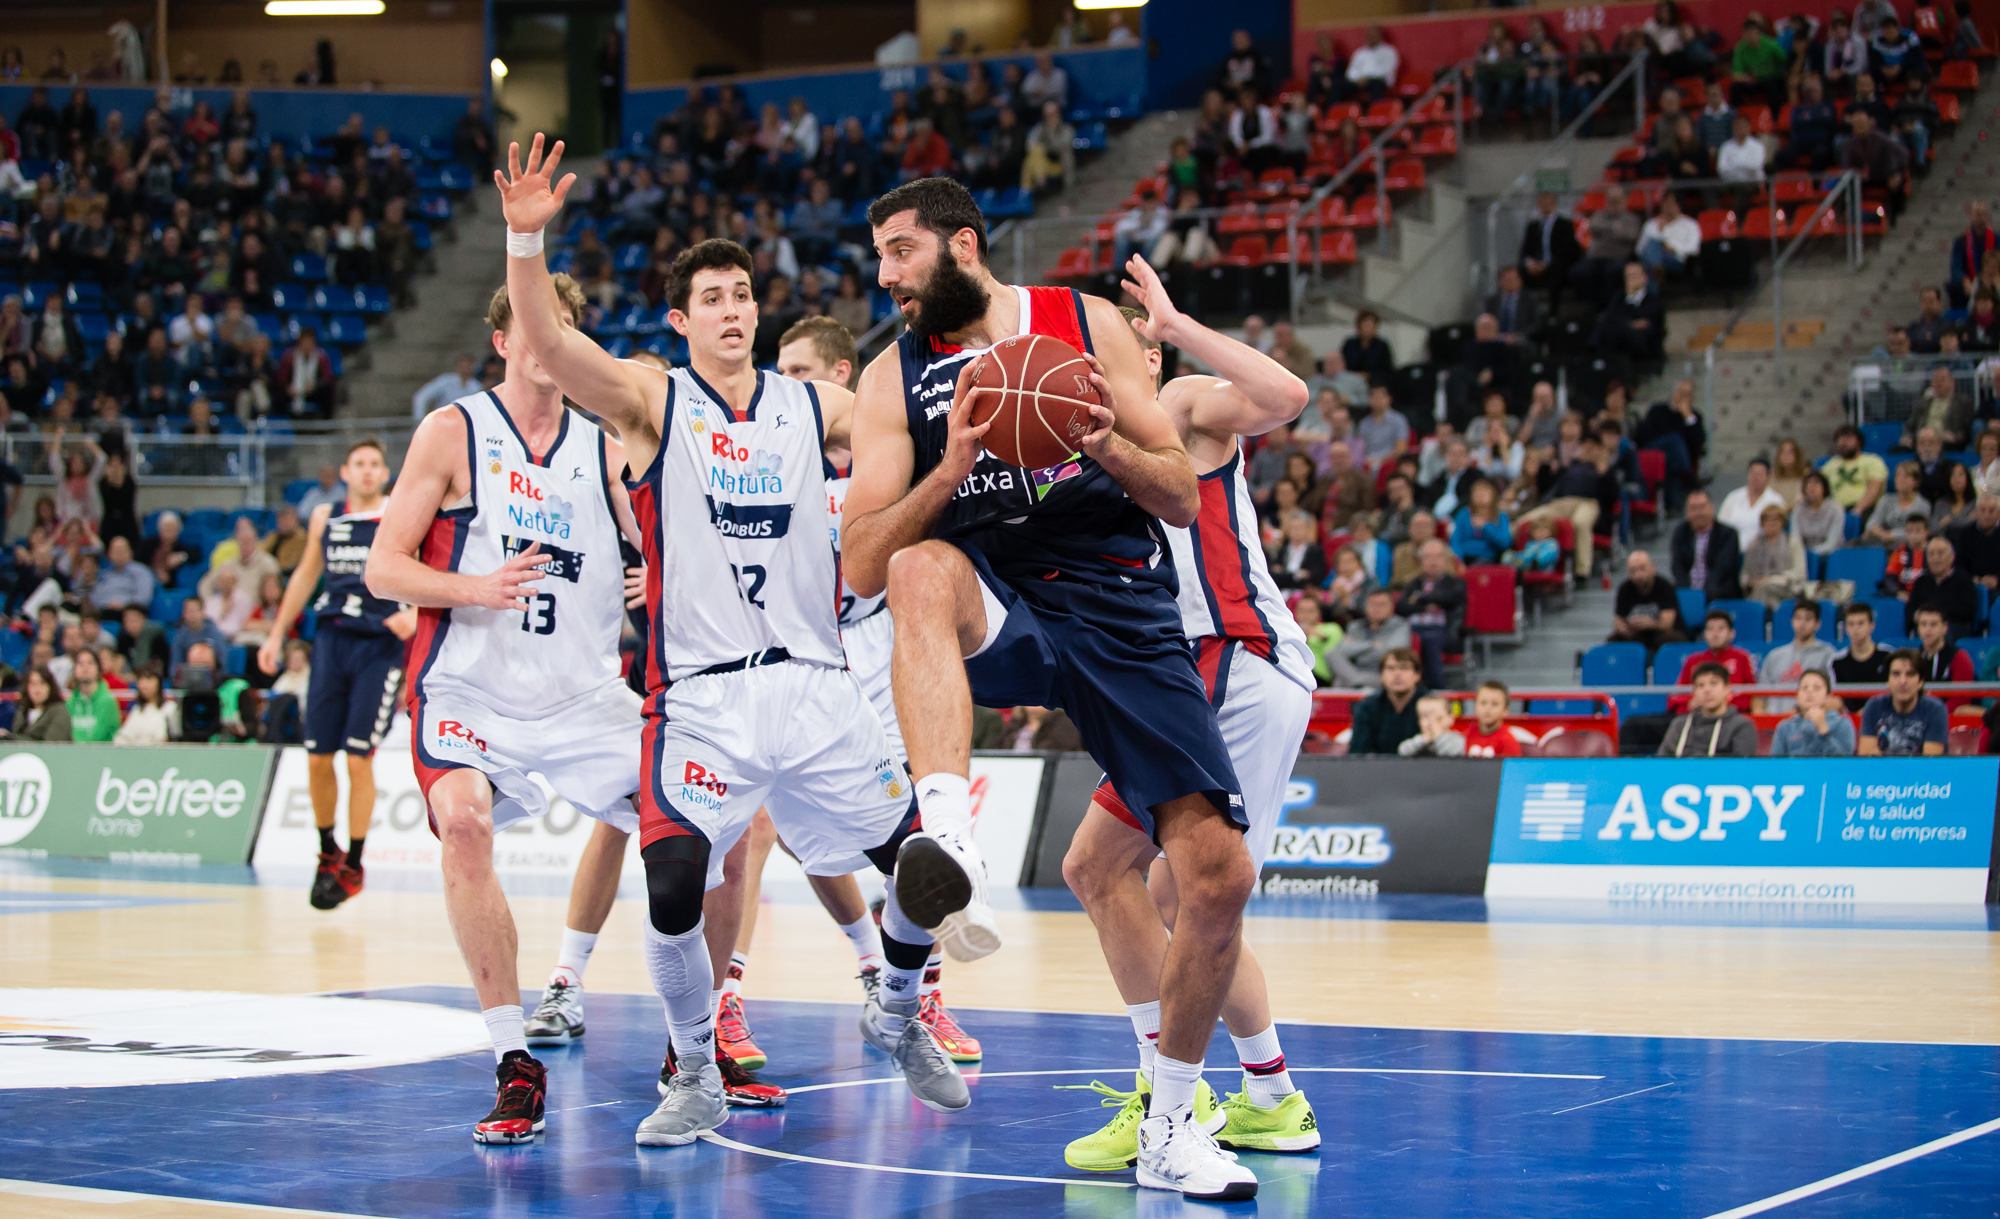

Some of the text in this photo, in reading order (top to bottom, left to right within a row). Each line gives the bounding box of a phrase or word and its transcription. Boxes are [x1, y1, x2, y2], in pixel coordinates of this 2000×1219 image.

[712, 431, 749, 462] Rio
[510, 471, 543, 501] Rio
[711, 466, 782, 494] Natura
[952, 471, 1014, 500] utxa
[508, 504, 571, 539] Natura
[521, 592, 557, 635] 13
[95, 766, 246, 818] befree
[684, 760, 727, 797] Rio
[1846, 782, 1951, 803] la seguridad
[87, 815, 144, 837] home
[1597, 784, 1805, 842] ASPY
[1845, 803, 1926, 824] y la salud
[1841, 823, 1967, 844] de tu empresa
[1264, 873, 1379, 896] deportistas
[1608, 879, 1856, 900] aspyprevencion.com
